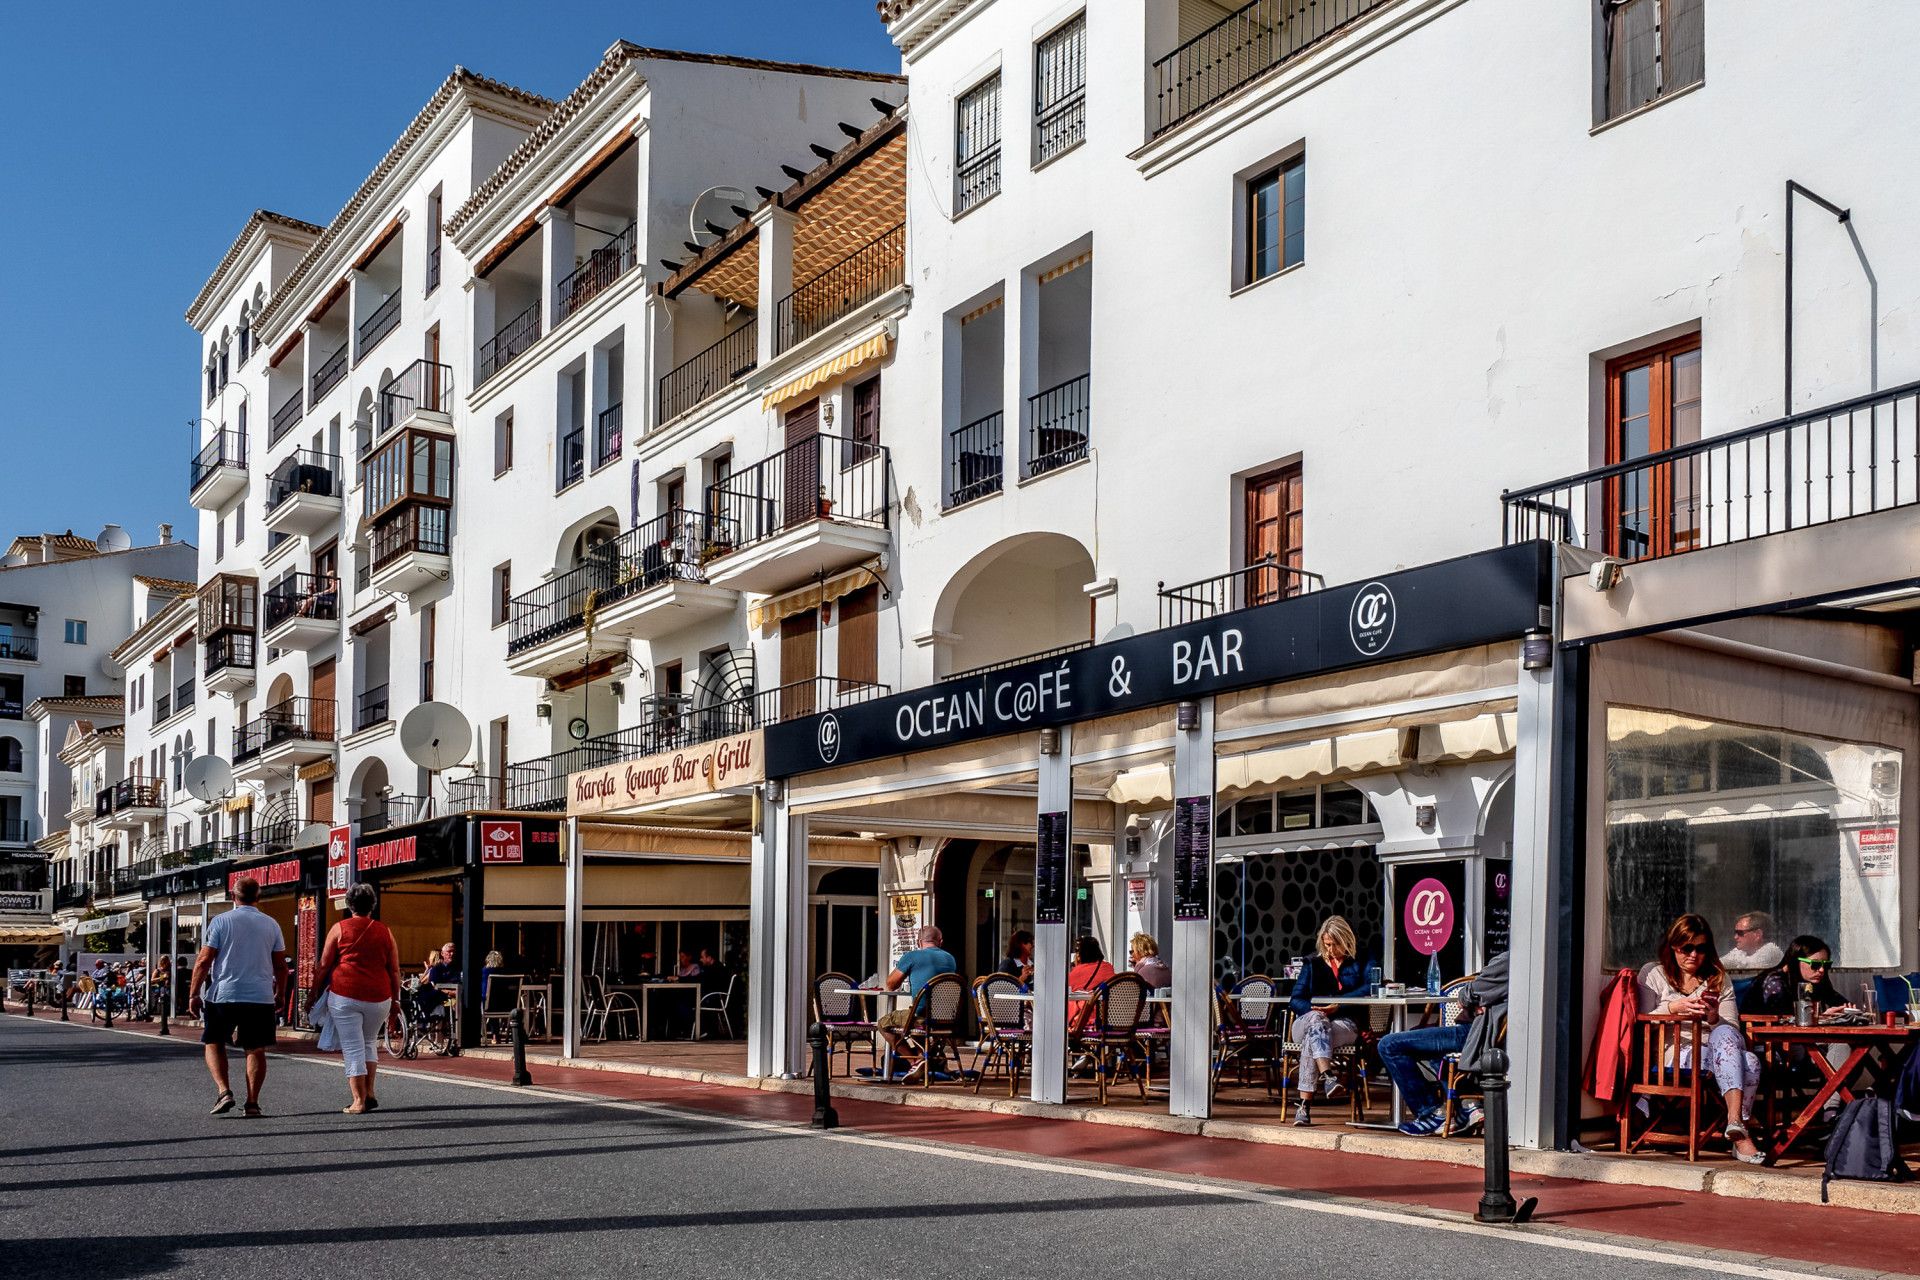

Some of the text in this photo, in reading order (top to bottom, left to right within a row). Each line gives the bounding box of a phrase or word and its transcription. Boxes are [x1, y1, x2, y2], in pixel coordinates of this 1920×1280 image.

[895, 628, 1244, 741] OCEAN C@FÉ & BAR
[576, 773, 616, 802] Karola
[625, 764, 669, 800] Lounge
[672, 753, 700, 784] Bar
[717, 740, 751, 781] Grill
[356, 835, 417, 871] TEPPANYAKI
[484, 845, 504, 858] FU
[268, 859, 300, 885] ASIATICO
